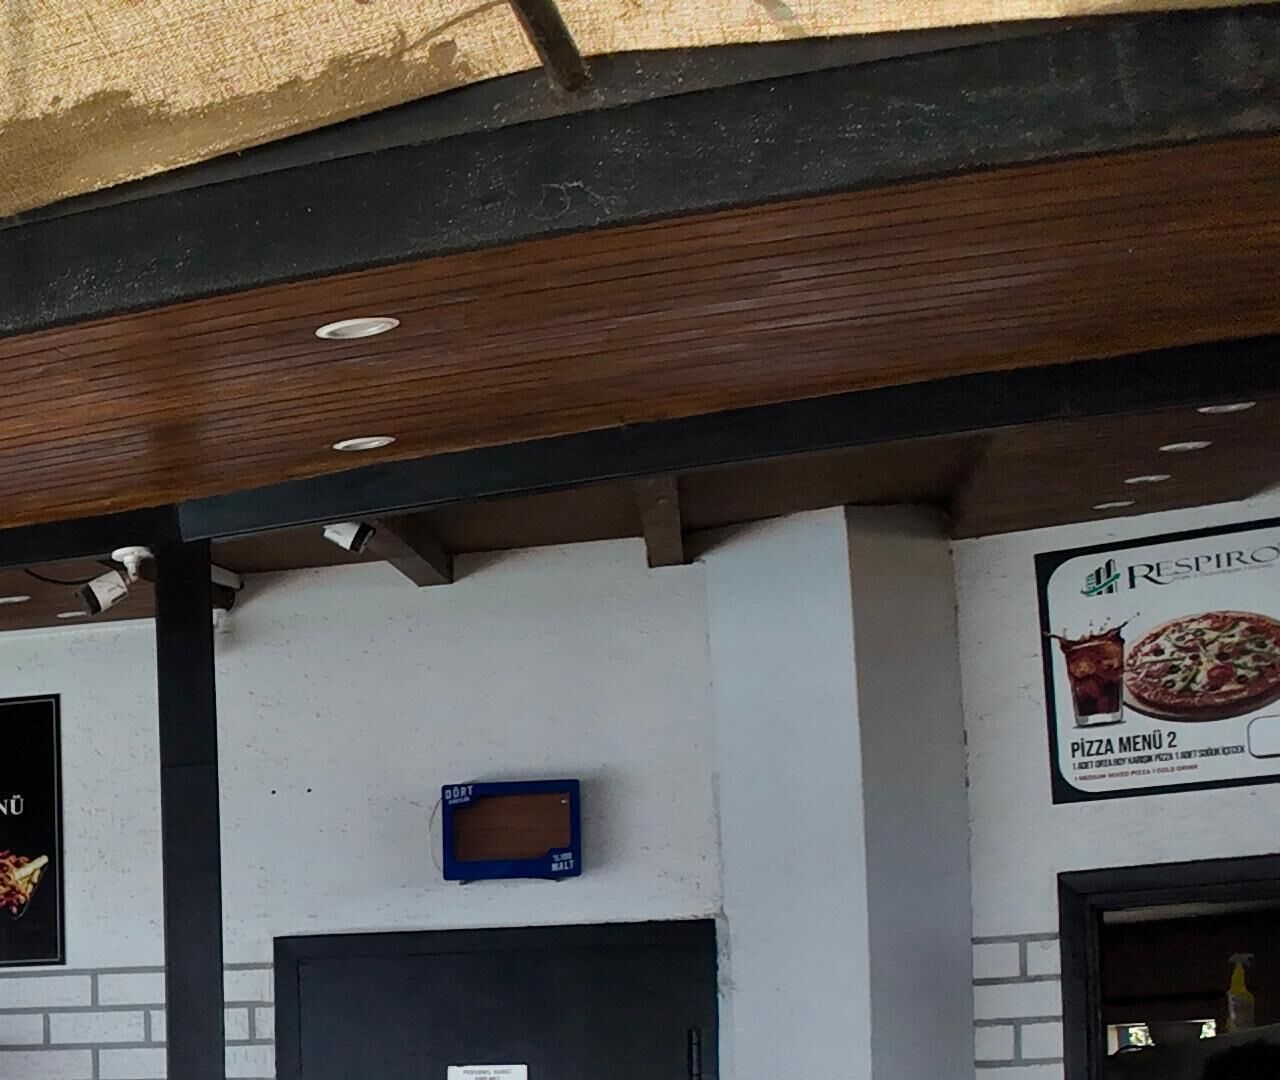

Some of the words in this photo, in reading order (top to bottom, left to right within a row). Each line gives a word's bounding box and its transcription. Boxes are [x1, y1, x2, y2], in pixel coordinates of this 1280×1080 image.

[1128, 545, 1280, 589] RESPIRO
[1071, 737, 1114, 758] PİZZA
[1118, 729, 1163, 753] MENÜ
[1167, 731, 1178, 748] 2
[551, 859, 574, 871] MALT
